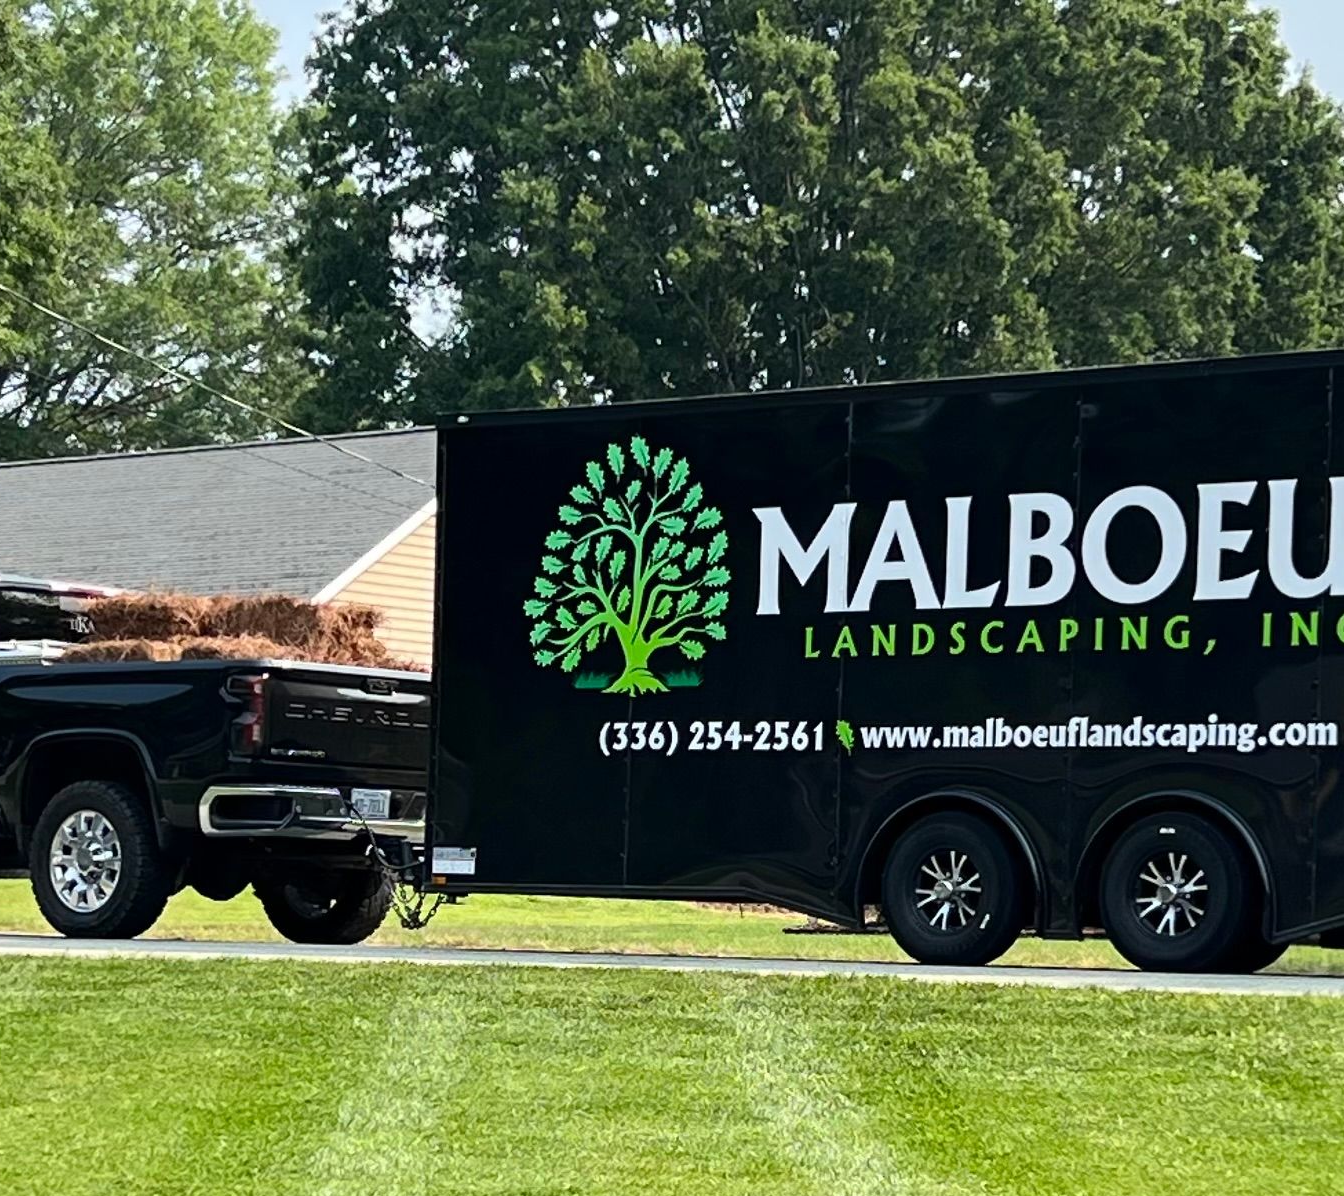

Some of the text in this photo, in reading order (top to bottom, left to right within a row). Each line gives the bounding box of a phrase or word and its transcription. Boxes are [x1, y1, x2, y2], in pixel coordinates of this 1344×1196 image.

[805, 615, 1215, 657] LANDSCAPING,
[599, 713, 1338, 757] (336) 254-2561 www.malboeuflandscaping.com
